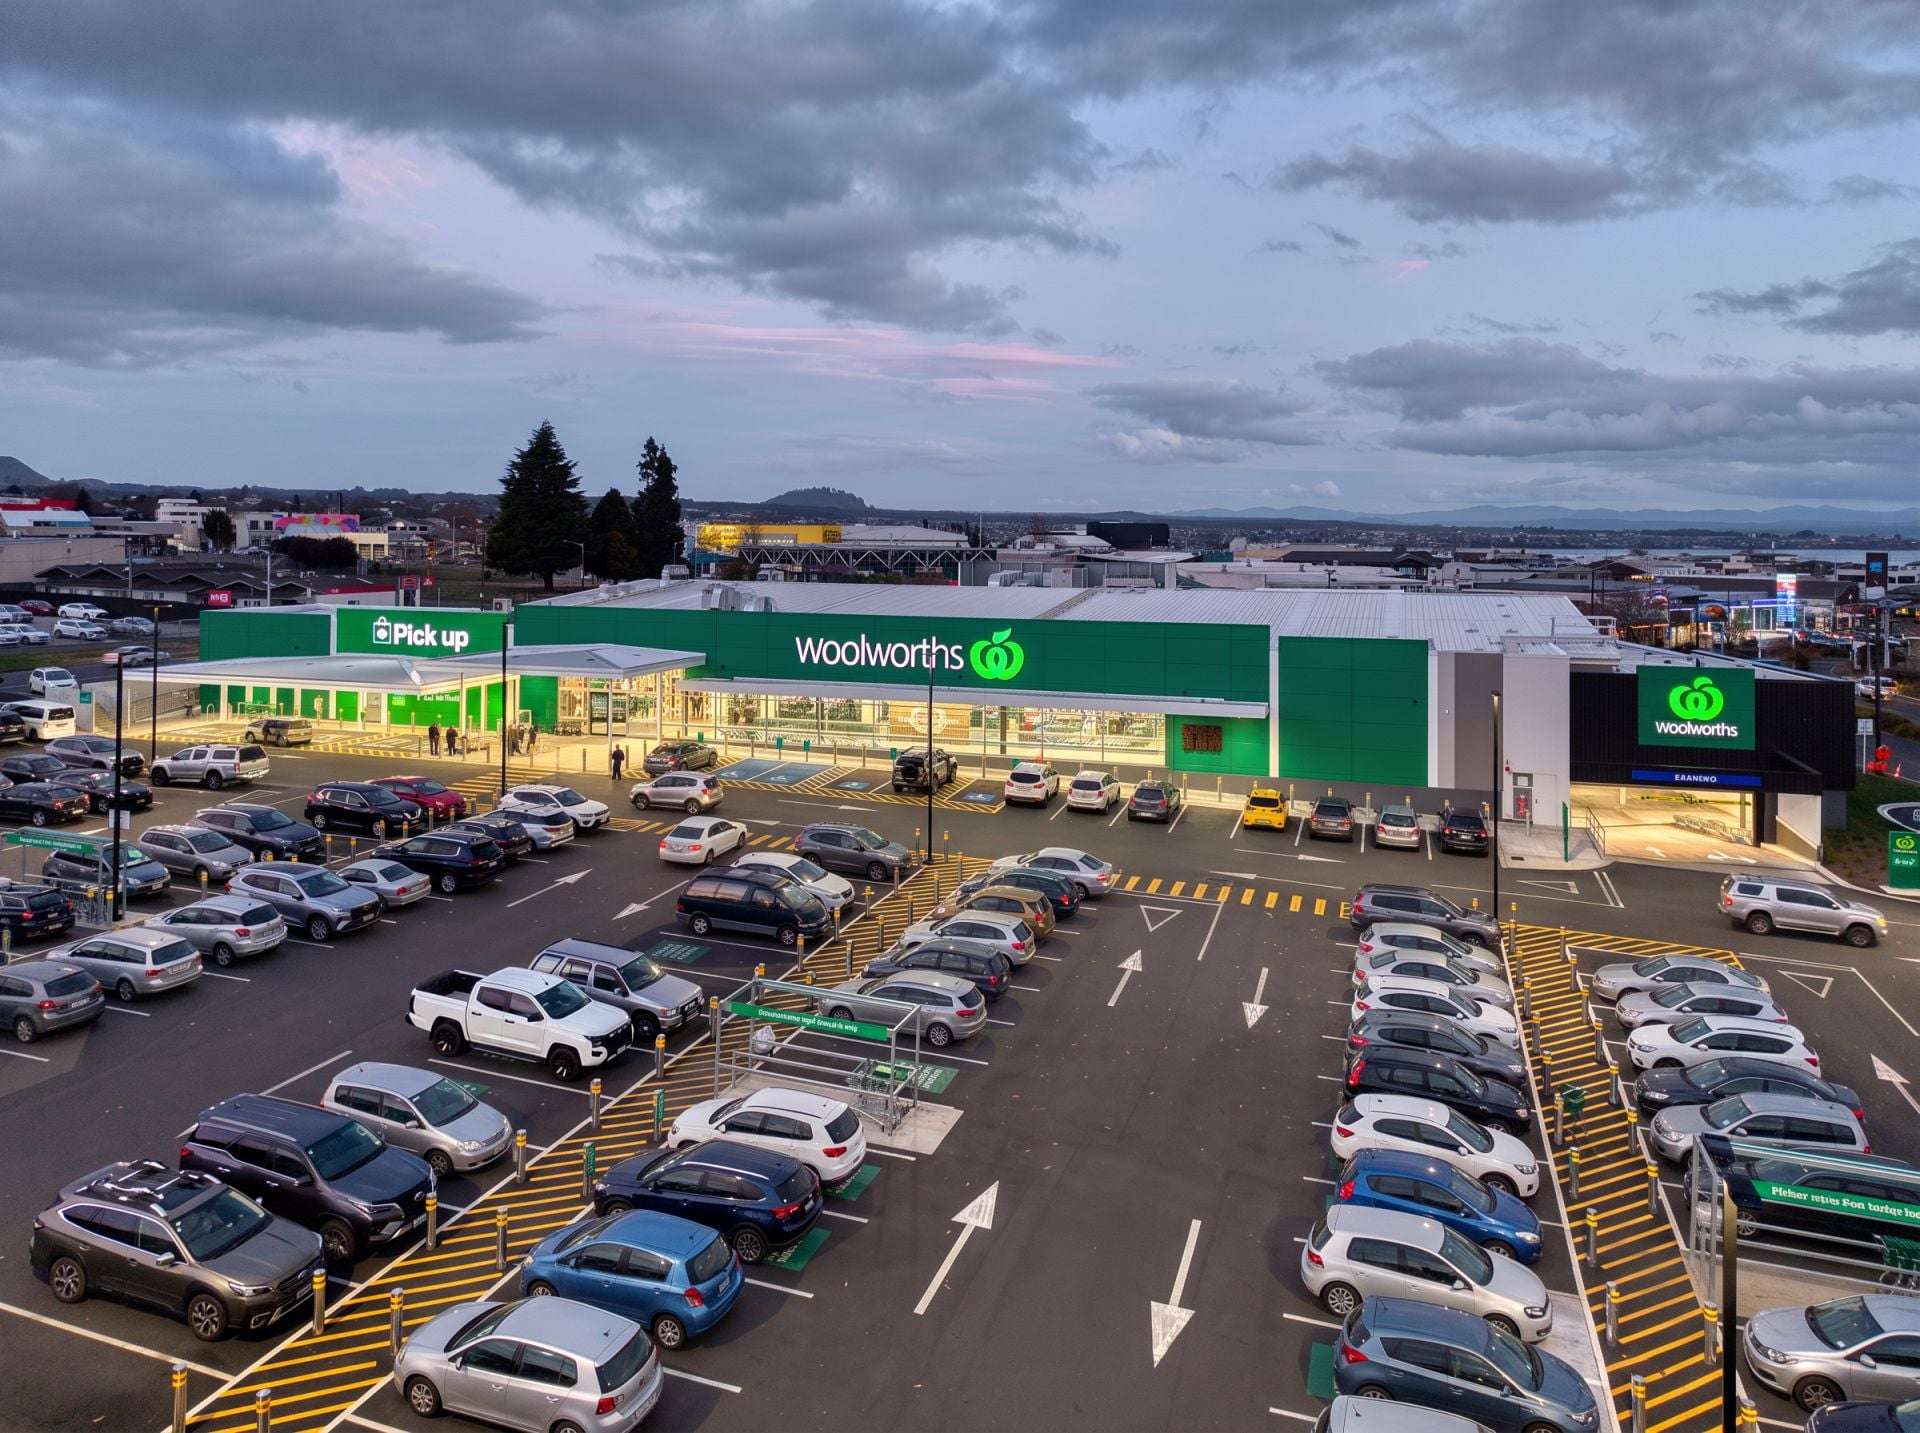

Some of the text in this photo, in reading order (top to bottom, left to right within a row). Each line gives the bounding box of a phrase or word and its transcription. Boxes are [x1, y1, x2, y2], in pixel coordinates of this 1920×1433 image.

[393, 623, 470, 653] Pick up
[795, 633, 965, 670] Woolworths
[1655, 721, 1739, 738] Woolworths
